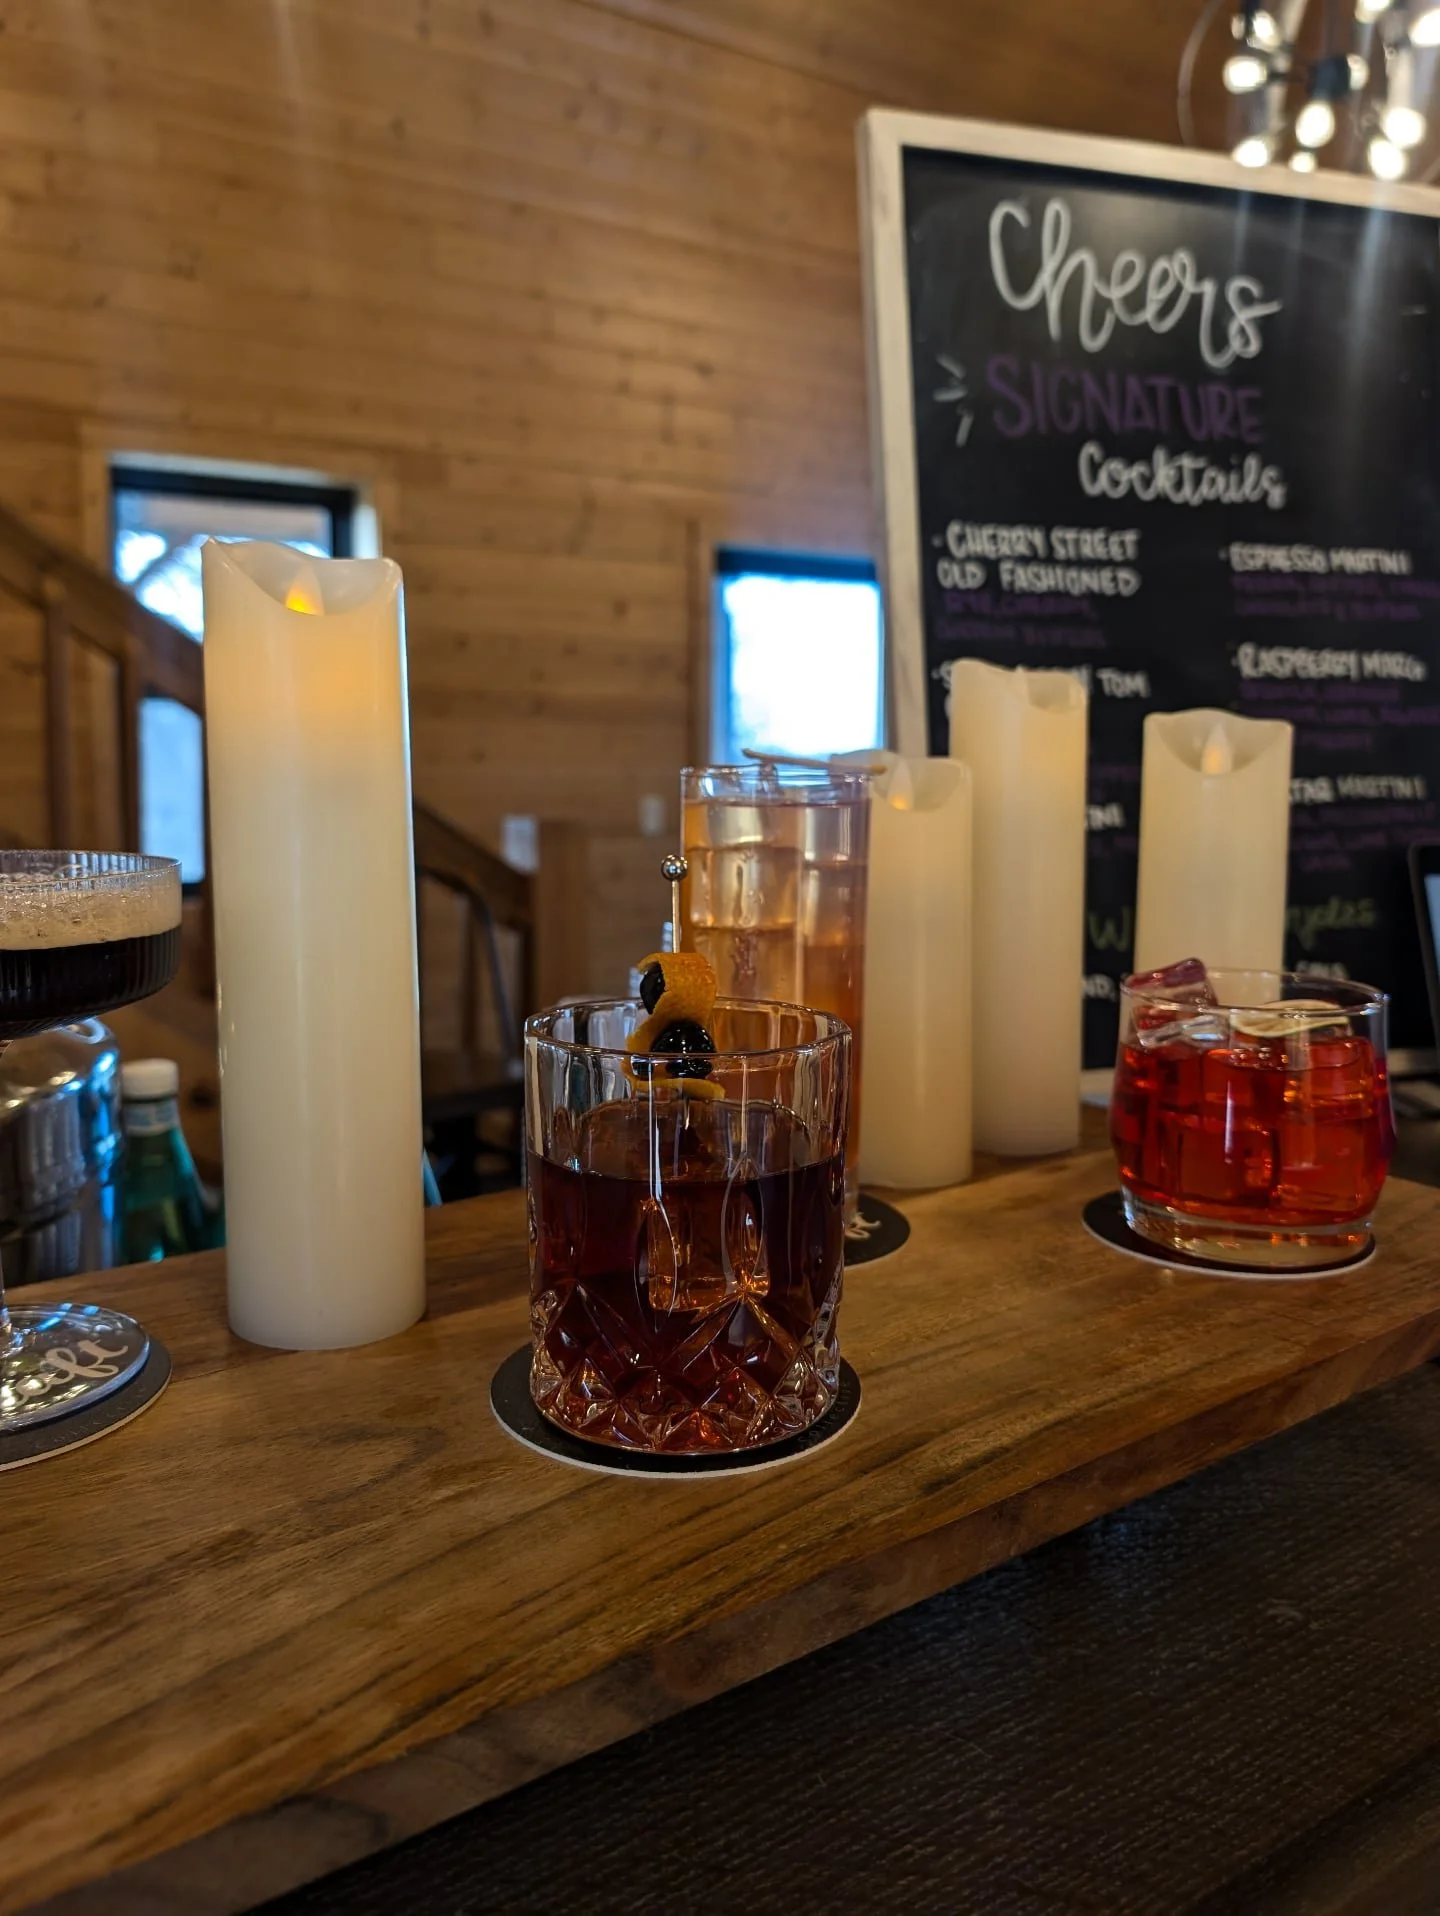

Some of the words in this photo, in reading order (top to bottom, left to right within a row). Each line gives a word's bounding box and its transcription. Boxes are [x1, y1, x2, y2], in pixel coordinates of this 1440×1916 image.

[989, 197, 1282, 369] Cheers
[985, 355, 1264, 444] SIGNATURE
[1078, 442, 1286, 510] Cocktails
[946, 519, 1047, 559] CHERRY
[1050, 526, 1140, 561] STREET
[1229, 541, 1328, 574] ESPRESSO
[937, 558, 986, 589] OLD
[999, 560, 1141, 597] FASHIONED
[1096, 667, 1151, 698] TOM
